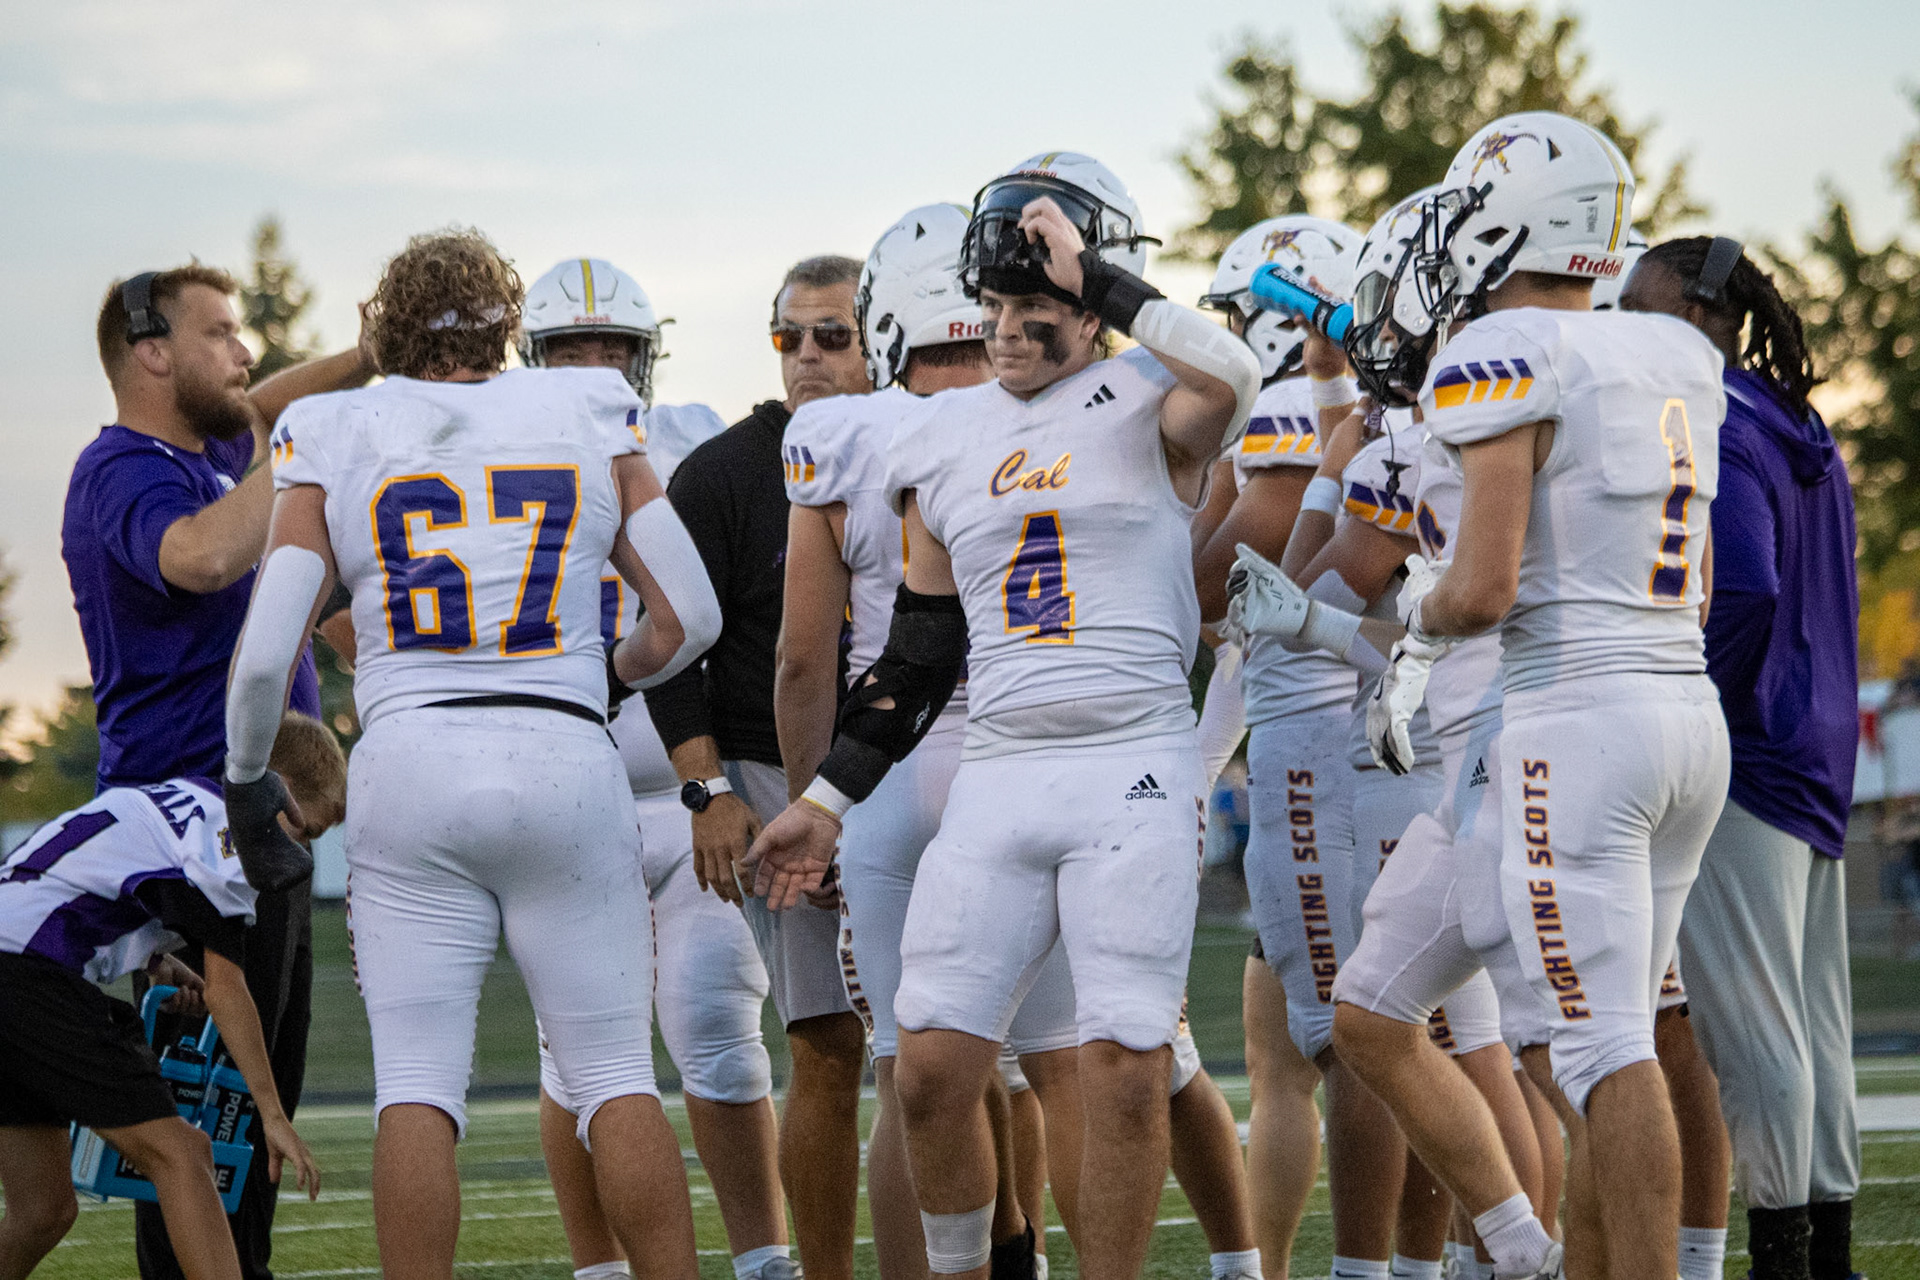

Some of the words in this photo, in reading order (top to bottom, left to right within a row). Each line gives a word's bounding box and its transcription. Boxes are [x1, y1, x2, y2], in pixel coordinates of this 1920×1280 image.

[988, 448, 1072, 498] Cal
[369, 463, 581, 658] 67
[1001, 509, 1076, 645] 4
[1125, 789, 1167, 800] adidas
[1287, 769, 1319, 863] SCOTS
[1523, 758, 1554, 868] SCOTS
[1528, 879, 1592, 1022] FIGHTING
